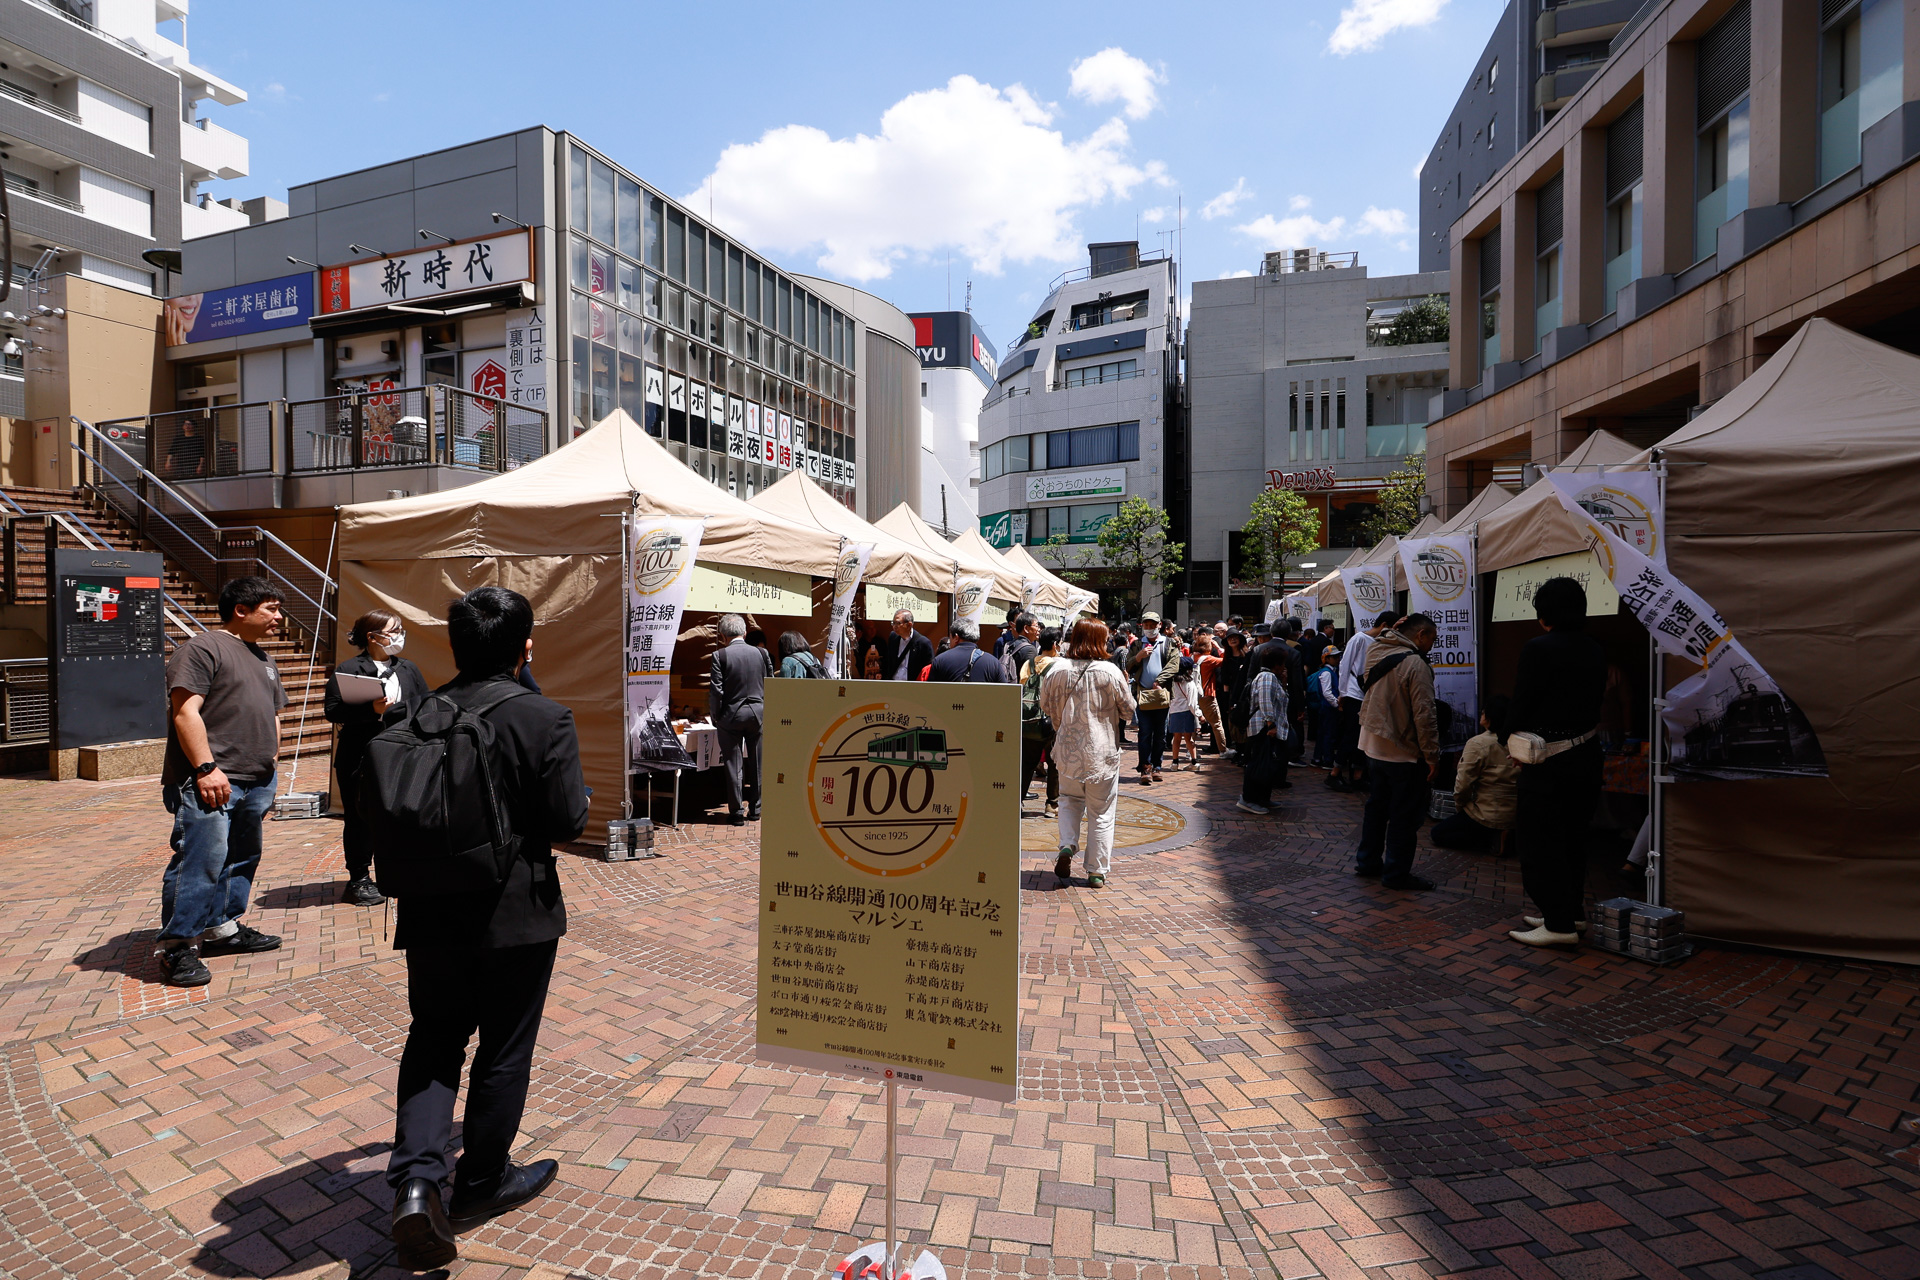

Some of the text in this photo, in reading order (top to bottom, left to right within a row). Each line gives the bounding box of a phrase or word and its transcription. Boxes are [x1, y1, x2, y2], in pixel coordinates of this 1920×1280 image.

[380, 243, 493, 299] 新時代
[212, 286, 298, 318] 三軒茶屋歯科
[529, 308, 543, 364] 入口は
[509, 329, 523, 403] 裏側です
[979, 342, 998, 381] SEIYU
[526, 388, 546, 401] (1F)
[647, 376, 804, 444] ハイボール150円
[729, 430, 855, 484] 深夜5時まで営業中
[1046, 476, 1121, 492] おうちのドクター
[1266, 465, 1336, 491] Denny's
[641, 548, 673, 573] 100
[65, 579, 77, 587] 1F
[727, 578, 782, 600] 赤堤商店街
[632, 634, 653, 652] 開通
[862, 711, 911, 727] 世田谷線
[821, 776, 835, 805] 開通
[842, 762, 935, 817] 100
[931, 803, 953, 816] 周年
[864, 831, 909, 841] since 1925
[773, 881, 1001, 922] 世田谷線開通100周年記念
[849, 909, 924, 932] マルシェ
[773, 924, 871, 945] 三軒茶屋銀座商店街
[772, 940, 837, 958] 太子堂商店街
[906, 938, 977, 959] 豪徳寺商店街
[771, 957, 845, 976] 若林中央商店会
[905, 958, 965, 974] 山下商店街
[771, 974, 859, 994] 世田谷駅前商店街
[905, 973, 965, 992] 赤堤商店街
[771, 990, 887, 1015] ボロ市通り桜栄会商店街
[906, 992, 988, 1013] 下高井戸商店街
[769, 1006, 888, 1032] 松陰神社通り松栄会商店街
[905, 1008, 1002, 1033] 東急電鉄株式会社
